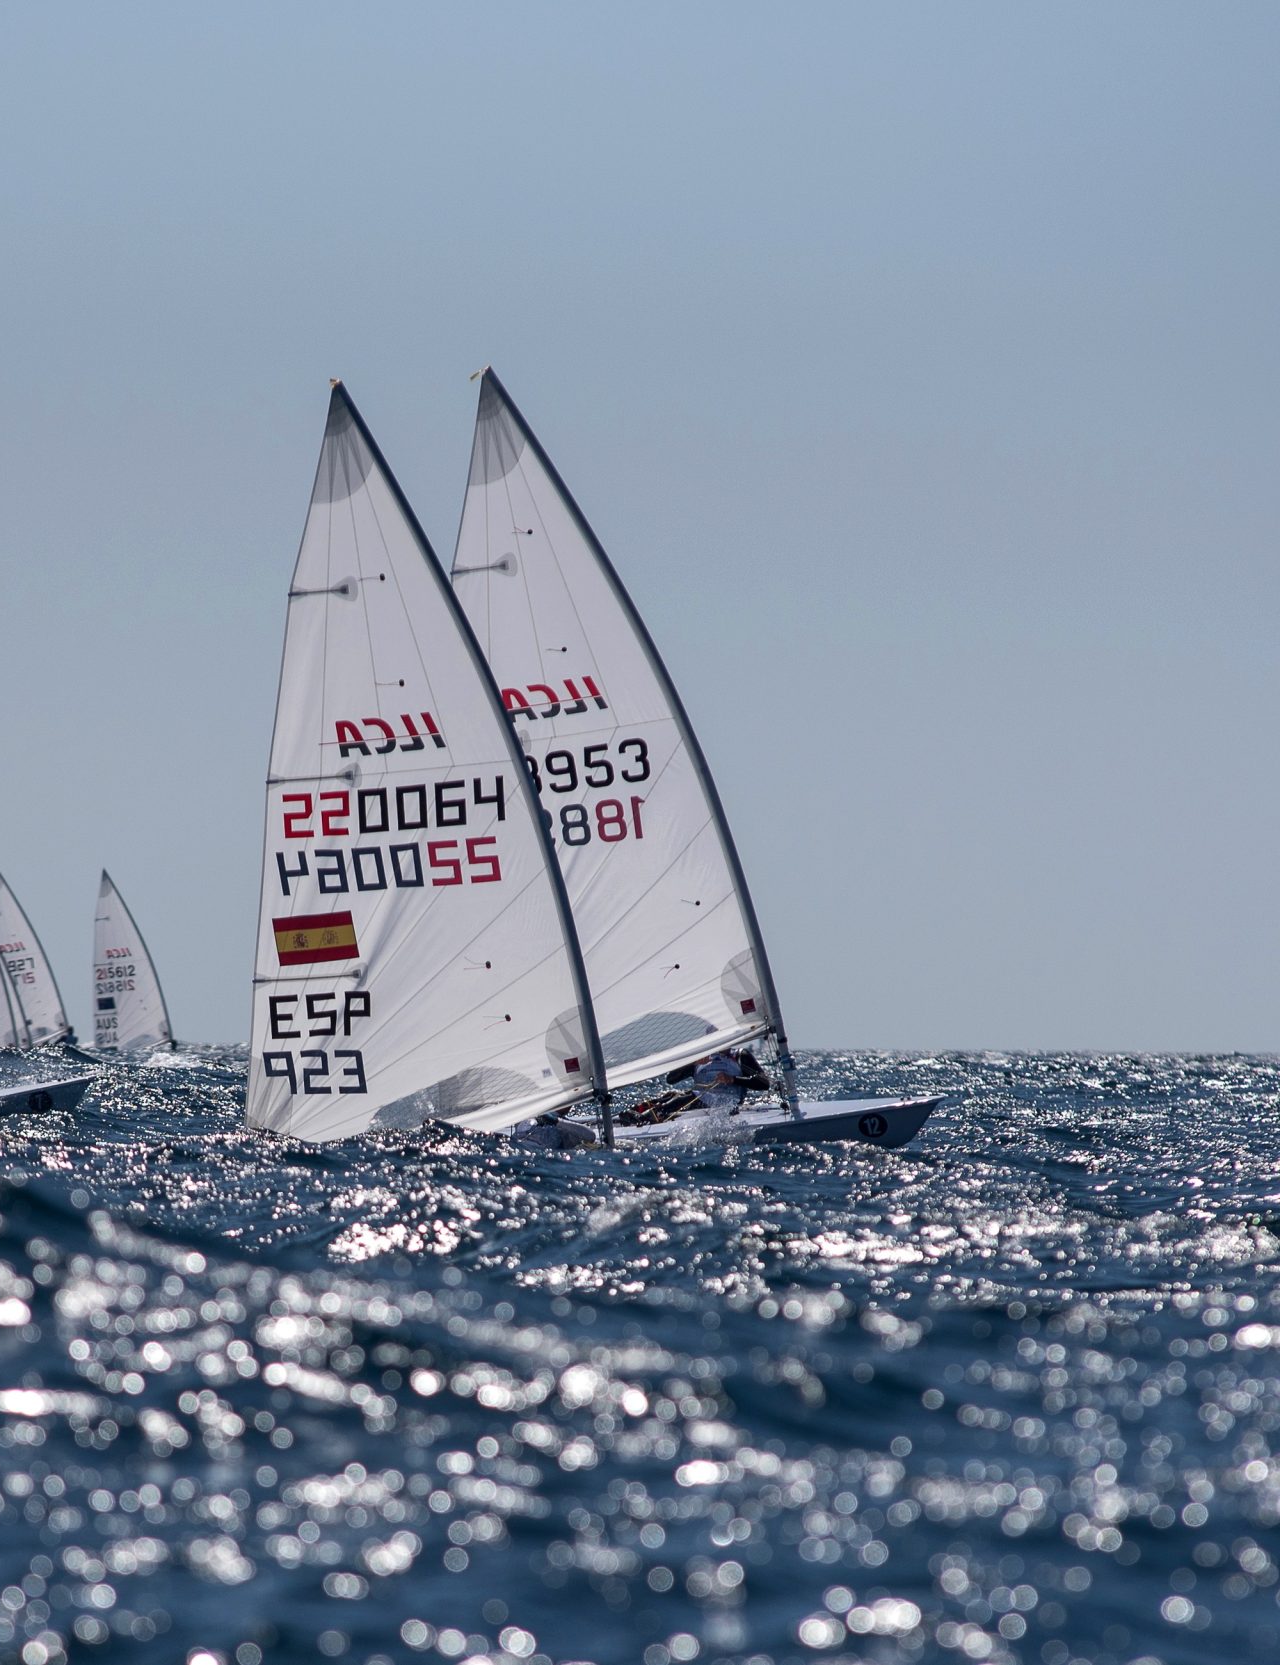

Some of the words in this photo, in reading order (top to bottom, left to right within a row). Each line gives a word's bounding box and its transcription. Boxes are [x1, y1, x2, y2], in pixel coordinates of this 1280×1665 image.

[282, 775, 506, 839] 220064
[96, 965, 136, 981] 215612
[268, 990, 371, 1039] ESP
[864, 1117, 881, 1135] 12
